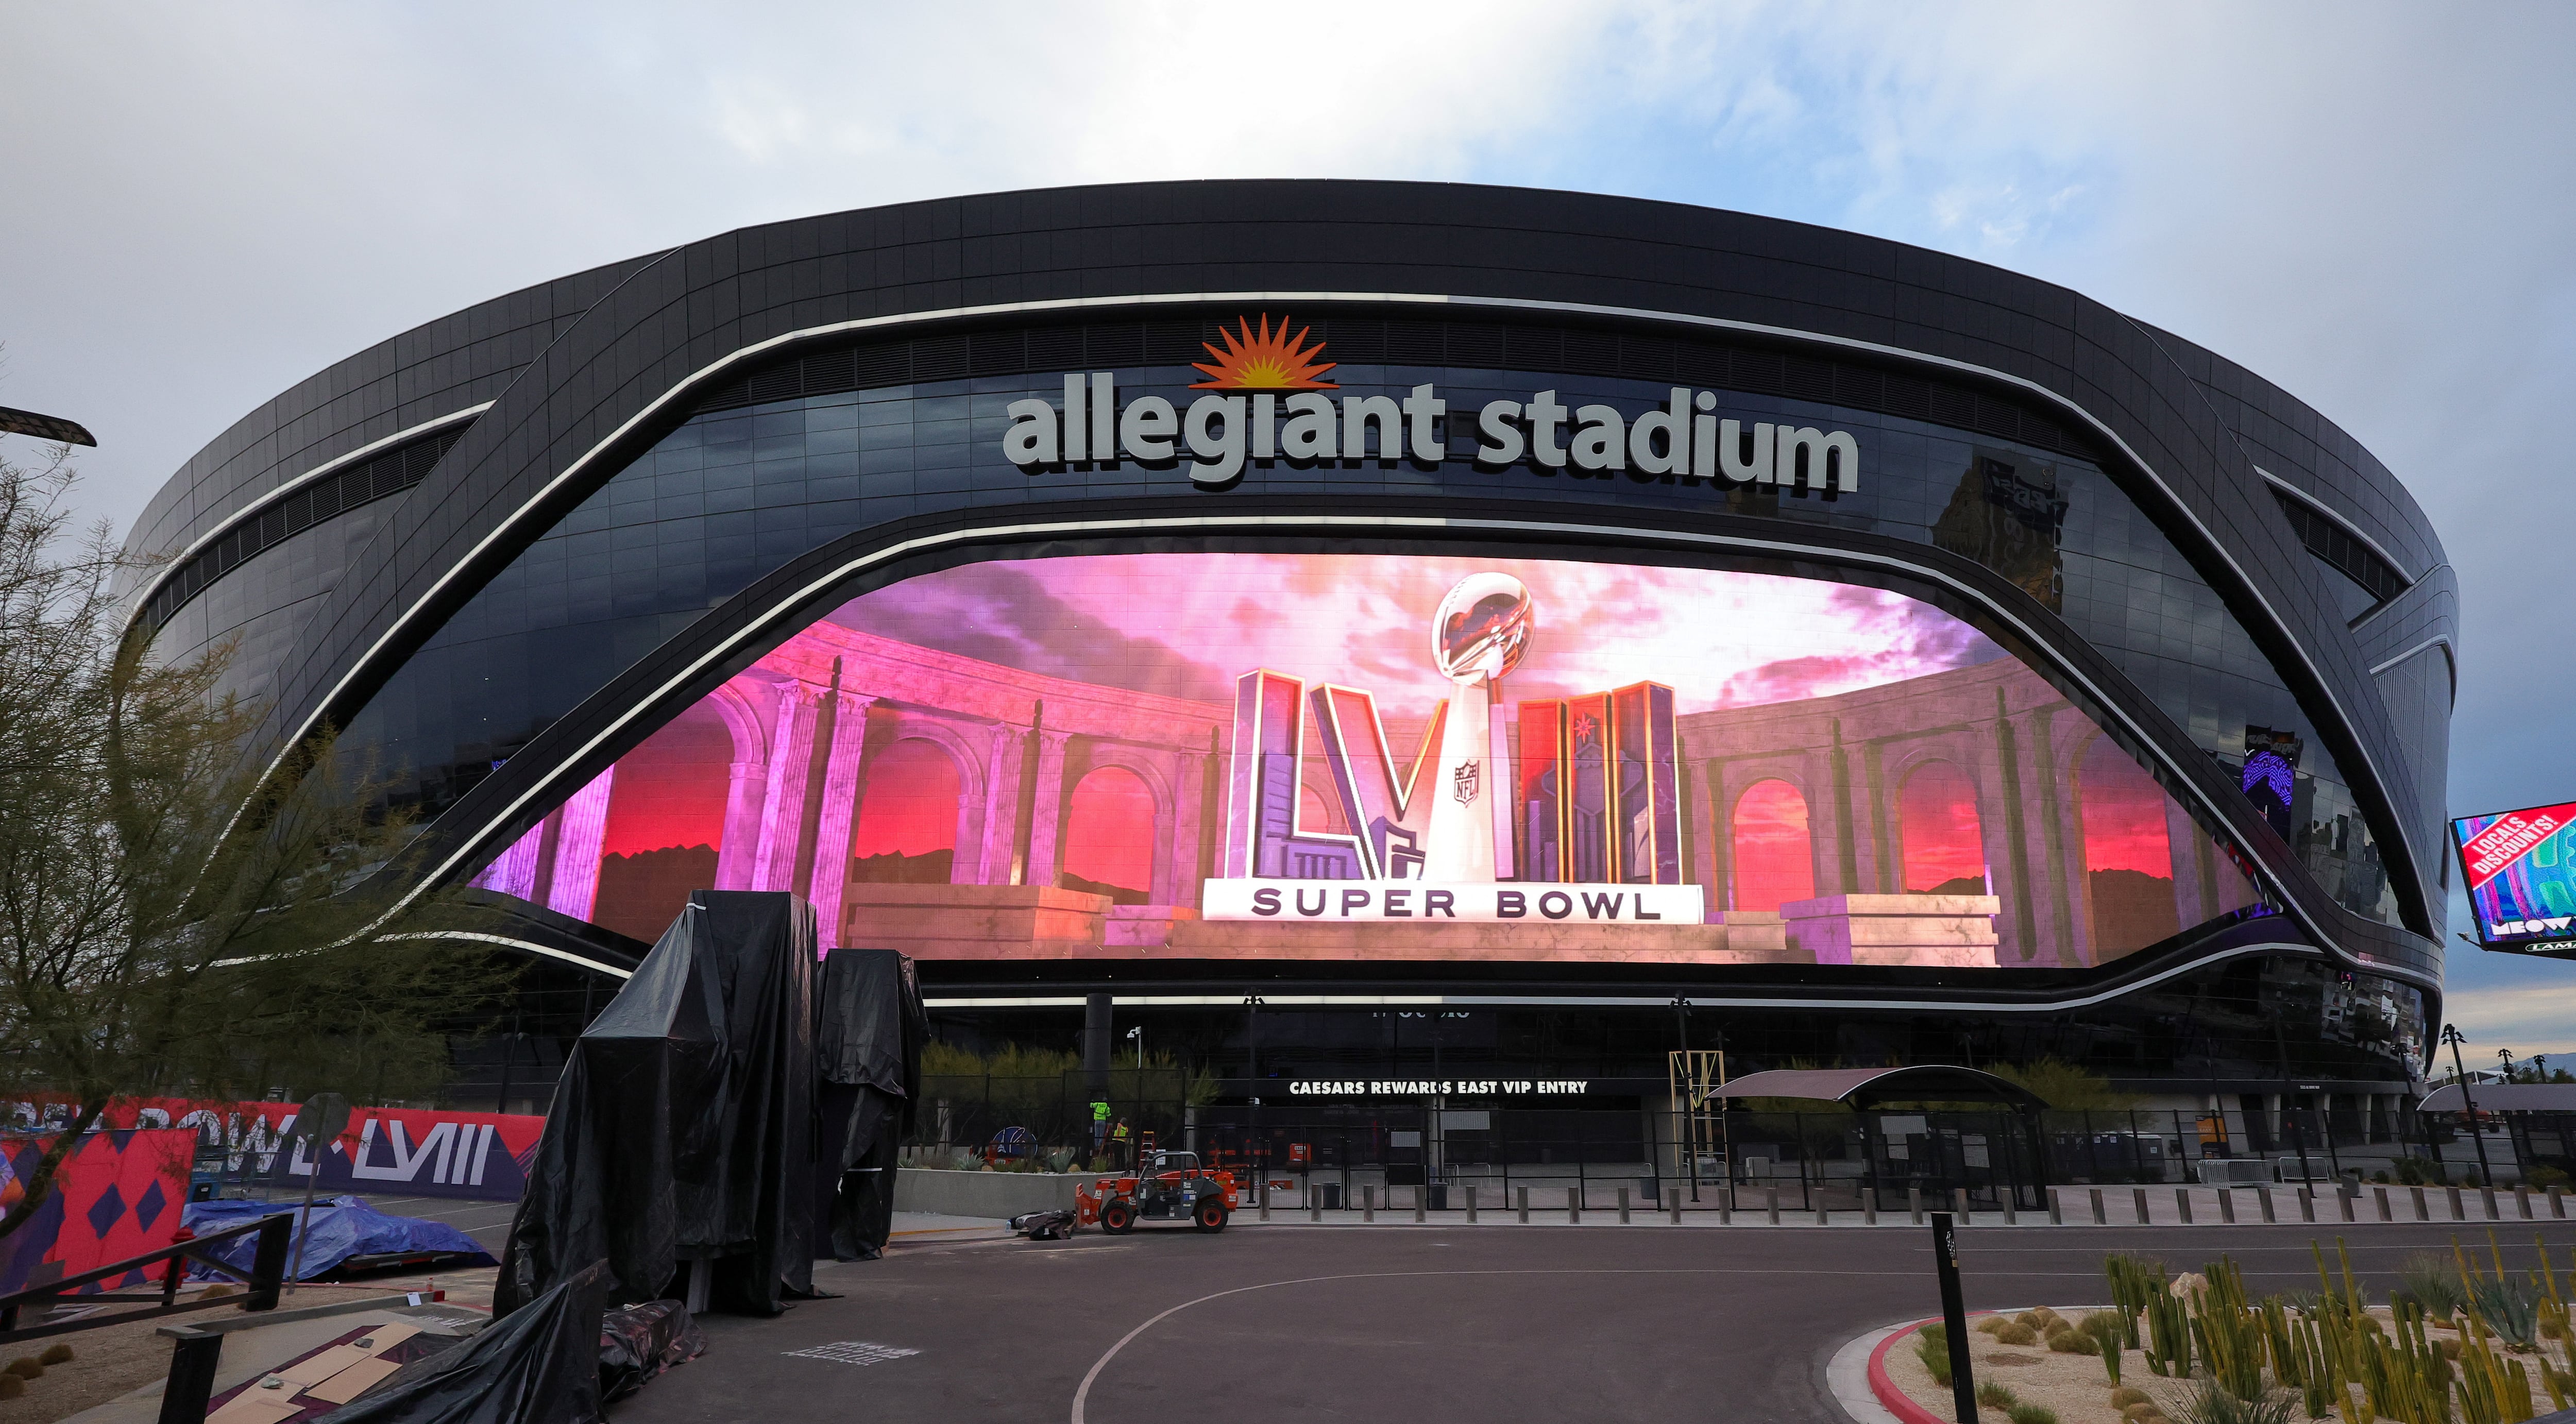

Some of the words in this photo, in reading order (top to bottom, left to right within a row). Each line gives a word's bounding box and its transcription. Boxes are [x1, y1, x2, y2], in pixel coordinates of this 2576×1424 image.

[1003, 372, 1447, 483] allegiant
[1478, 387, 1859, 492] stadium
[1456, 779, 1474, 799] NFL
[2471, 817, 2527, 855] LOCALS
[2472, 815, 2558, 875] DISCOUNTS!
[1251, 888, 1456, 918] SUPER
[1497, 890, 1660, 921] BOWL
[2490, 916, 2572, 935] MEOW
[2532, 942, 2576, 951] LAM
[1289, 1081, 1365, 1095] CAESARS
[1371, 1081, 1452, 1094] REWARDS
[1458, 1081, 1498, 1094] EAST
[1502, 1081, 1532, 1094] VIP
[1537, 1081, 1588, 1094] ENTRY
[352, 1118, 495, 1186] LVIII
